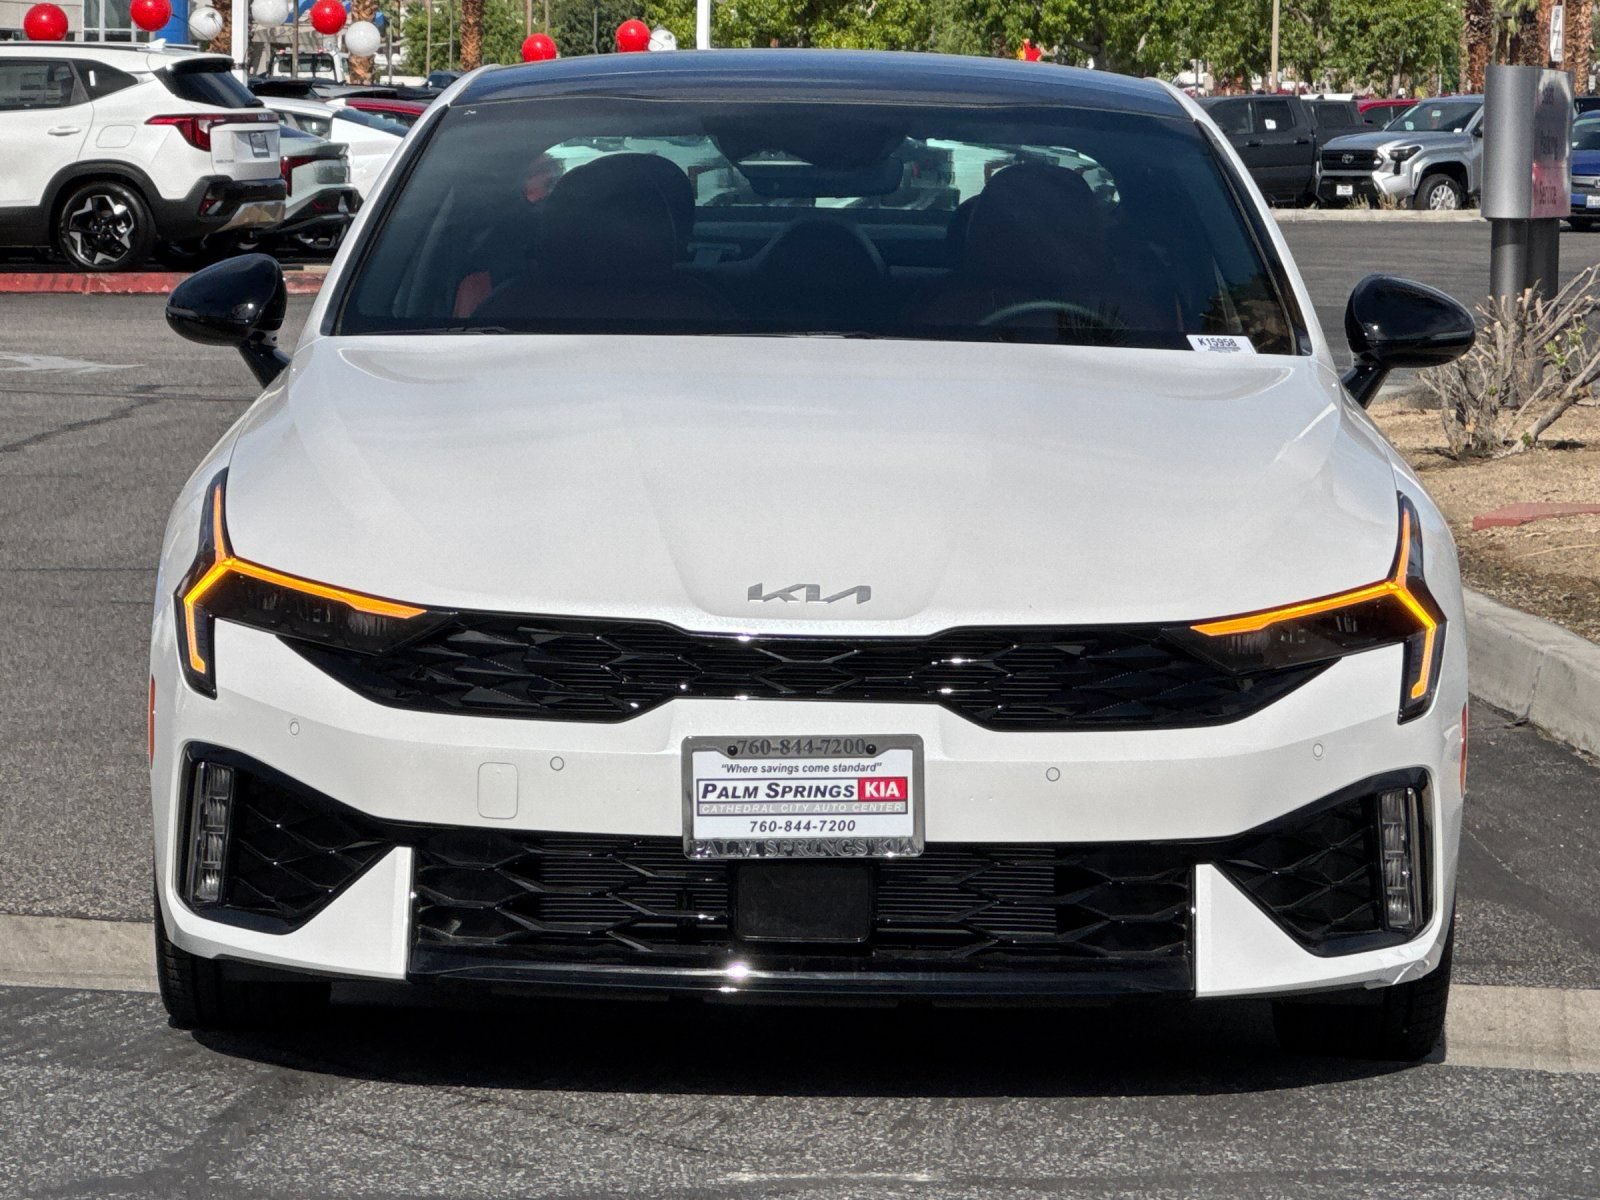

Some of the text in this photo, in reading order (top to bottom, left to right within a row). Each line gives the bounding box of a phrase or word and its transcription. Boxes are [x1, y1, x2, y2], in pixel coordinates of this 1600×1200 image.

[736, 738, 866, 755] 760-844-7200
[761, 763, 799, 775] savings
[802, 764, 830, 772] come
[701, 782, 855, 799] PALM SPRINGS
[865, 781, 900, 797] KIA
[702, 803, 902, 814] CATHEDRAL CITY AUTO CENTER
[750, 819, 856, 832] 760-844-7200
[764, 838, 868, 857] SPRINGS
